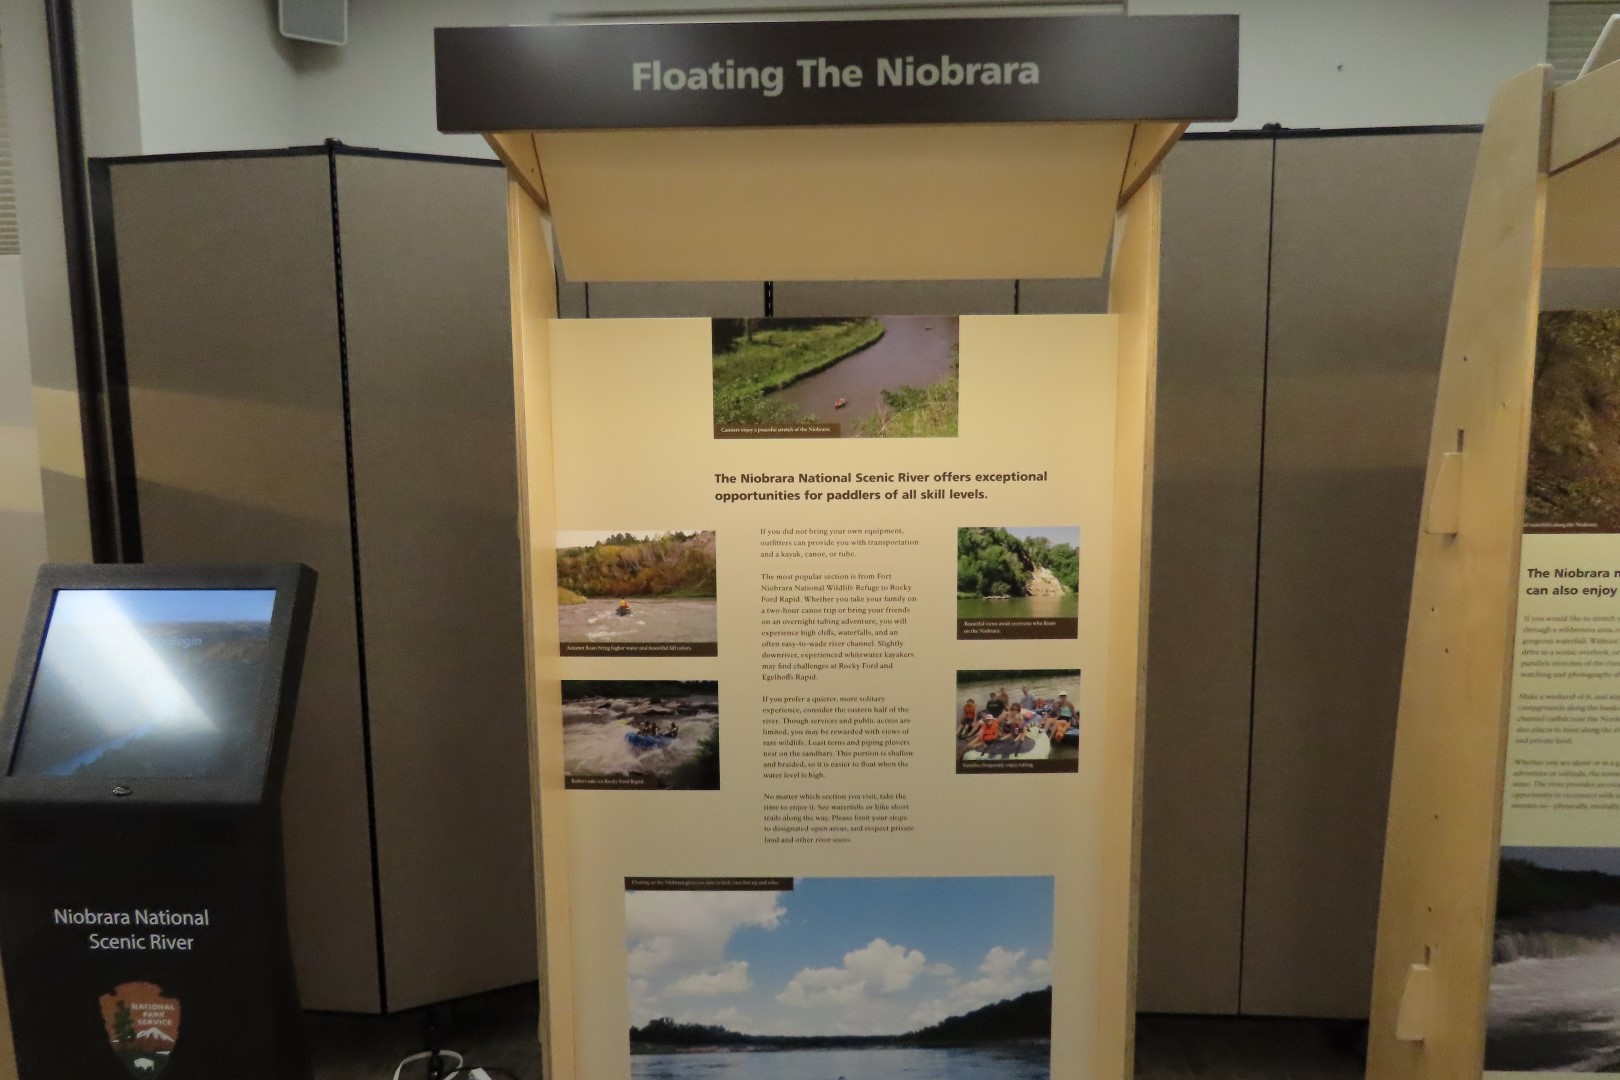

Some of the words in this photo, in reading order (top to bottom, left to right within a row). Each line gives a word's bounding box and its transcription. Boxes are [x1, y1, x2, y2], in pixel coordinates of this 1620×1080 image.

[632, 58, 783, 97] Floating
[796, 56, 862, 87] The
[877, 54, 1039, 85] Niobrara
[714, 473, 736, 483] The
[740, 473, 794, 482] Niobrara
[798, 472, 851, 482] National
[855, 472, 894, 482] Scenic
[898, 472, 929, 482] River
[933, 471, 971, 481] offers
[975, 471, 1046, 483] exceptional
[714, 490, 800, 502] opportunities
[804, 490, 822, 500] for
[826, 489, 880, 502] paddlers
[884, 489, 898, 499] of
[902, 489, 916, 499] all
[920, 489, 944, 499] skill
[949, 488, 987, 498] levels.
[808, 528, 828, 536] bring
[807, 539, 834, 547] provide
[780, 550, 803, 558] kayak,
[1527, 568, 1549, 577] The
[1554, 568, 1609, 577] Niobrara
[794, 573, 822, 581] popular
[855, 584, 879, 592] Refuge
[890, 584, 911, 592] Rocky
[1552, 585, 1578, 595] also
[1582, 585, 1617, 597] enjoy
[884, 595, 905, 603] family
[847, 606, 866, 614] bring
[782, 618, 814, 626] overnight
[816, 618, 839, 626] tubing
[837, 628, 873, 636] waterfalls,
[169, 636, 202, 649] Begin
[781, 640, 826, 648] easy-to-wade
[877, 640, 903, 648] Slightly
[800, 651, 842, 659] experienced
[884, 651, 914, 659] kayakers
[793, 662, 828, 670] challenges
[838, 662, 860, 670] Rocky
[784, 695, 804, 703] prefer
[859, 695, 885, 703] solitary
[54, 908, 130, 924] Niobrara
[134, 909, 208, 925] National
[89, 933, 145, 949] Scenic
[150, 934, 193, 949] River
